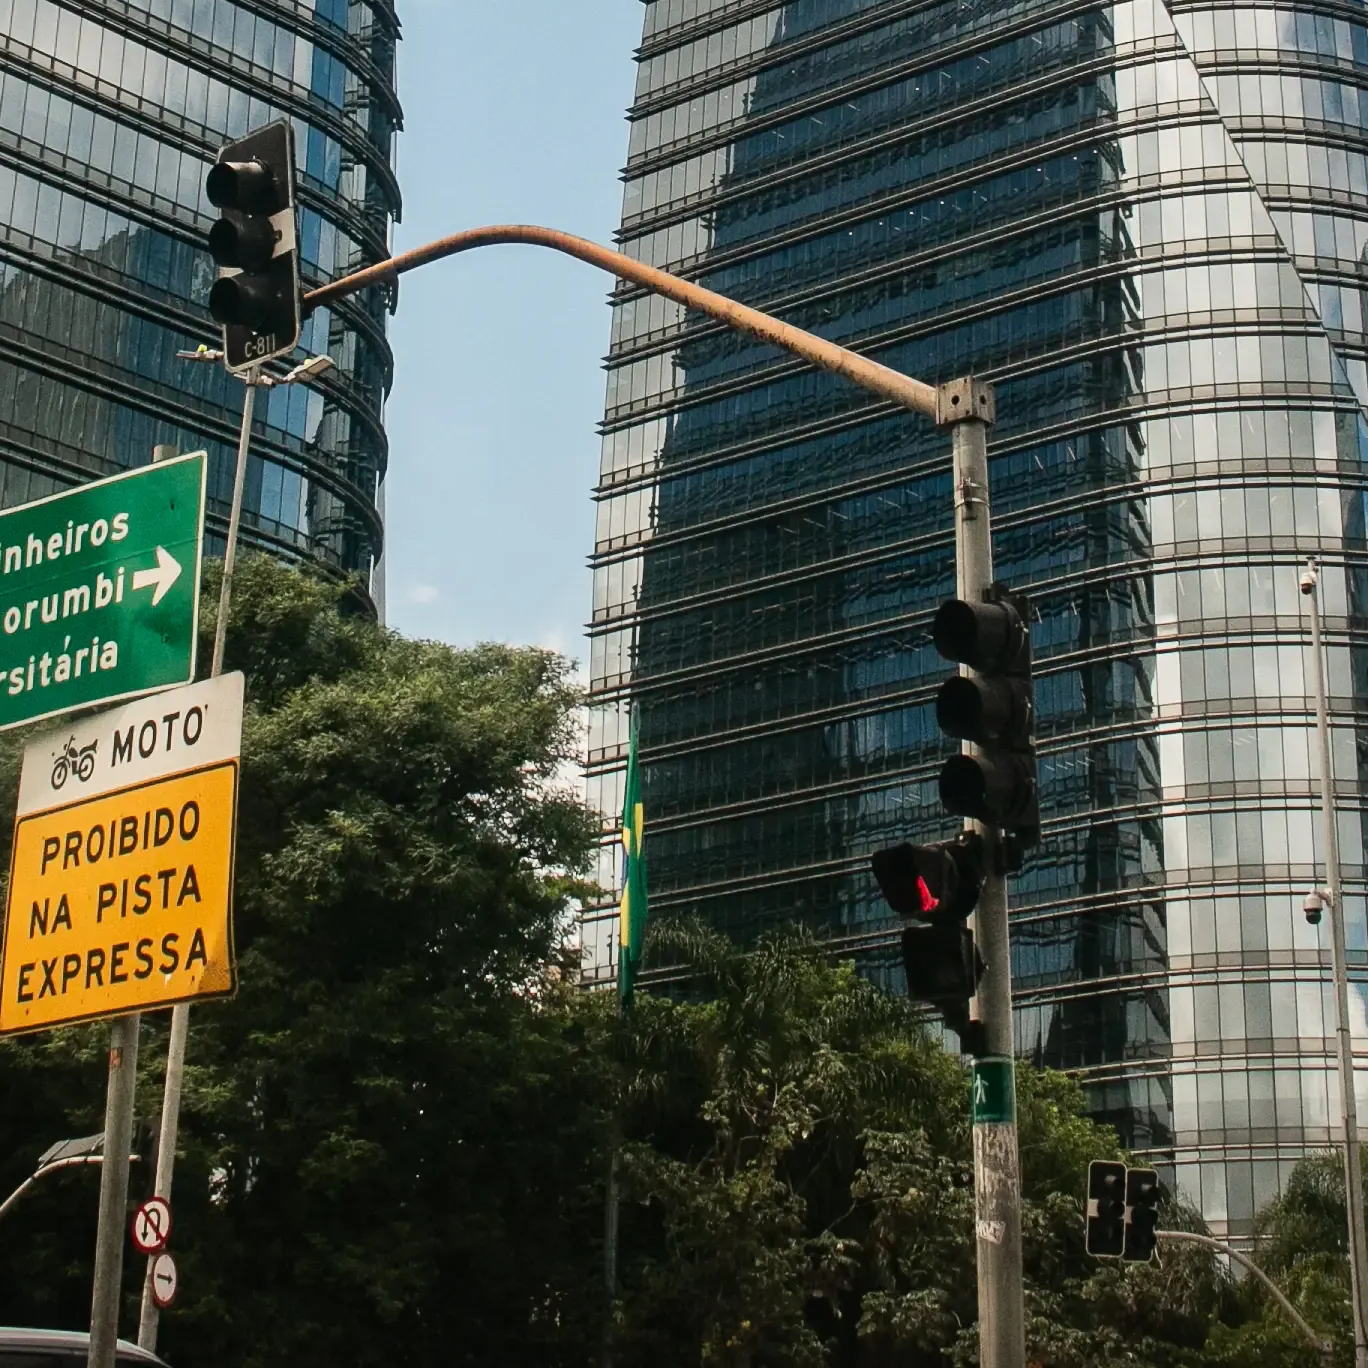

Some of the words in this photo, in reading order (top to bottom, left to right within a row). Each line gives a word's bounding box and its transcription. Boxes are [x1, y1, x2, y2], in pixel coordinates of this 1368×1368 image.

[244, 333, 276, 358] C-811
[111, 705, 203, 768] MOTO
[41, 800, 200, 876] PROIBIDO
[29, 893, 72, 939] NA
[96, 864, 202, 923] PISTA
[17, 927, 208, 1003] EXPRESSA
